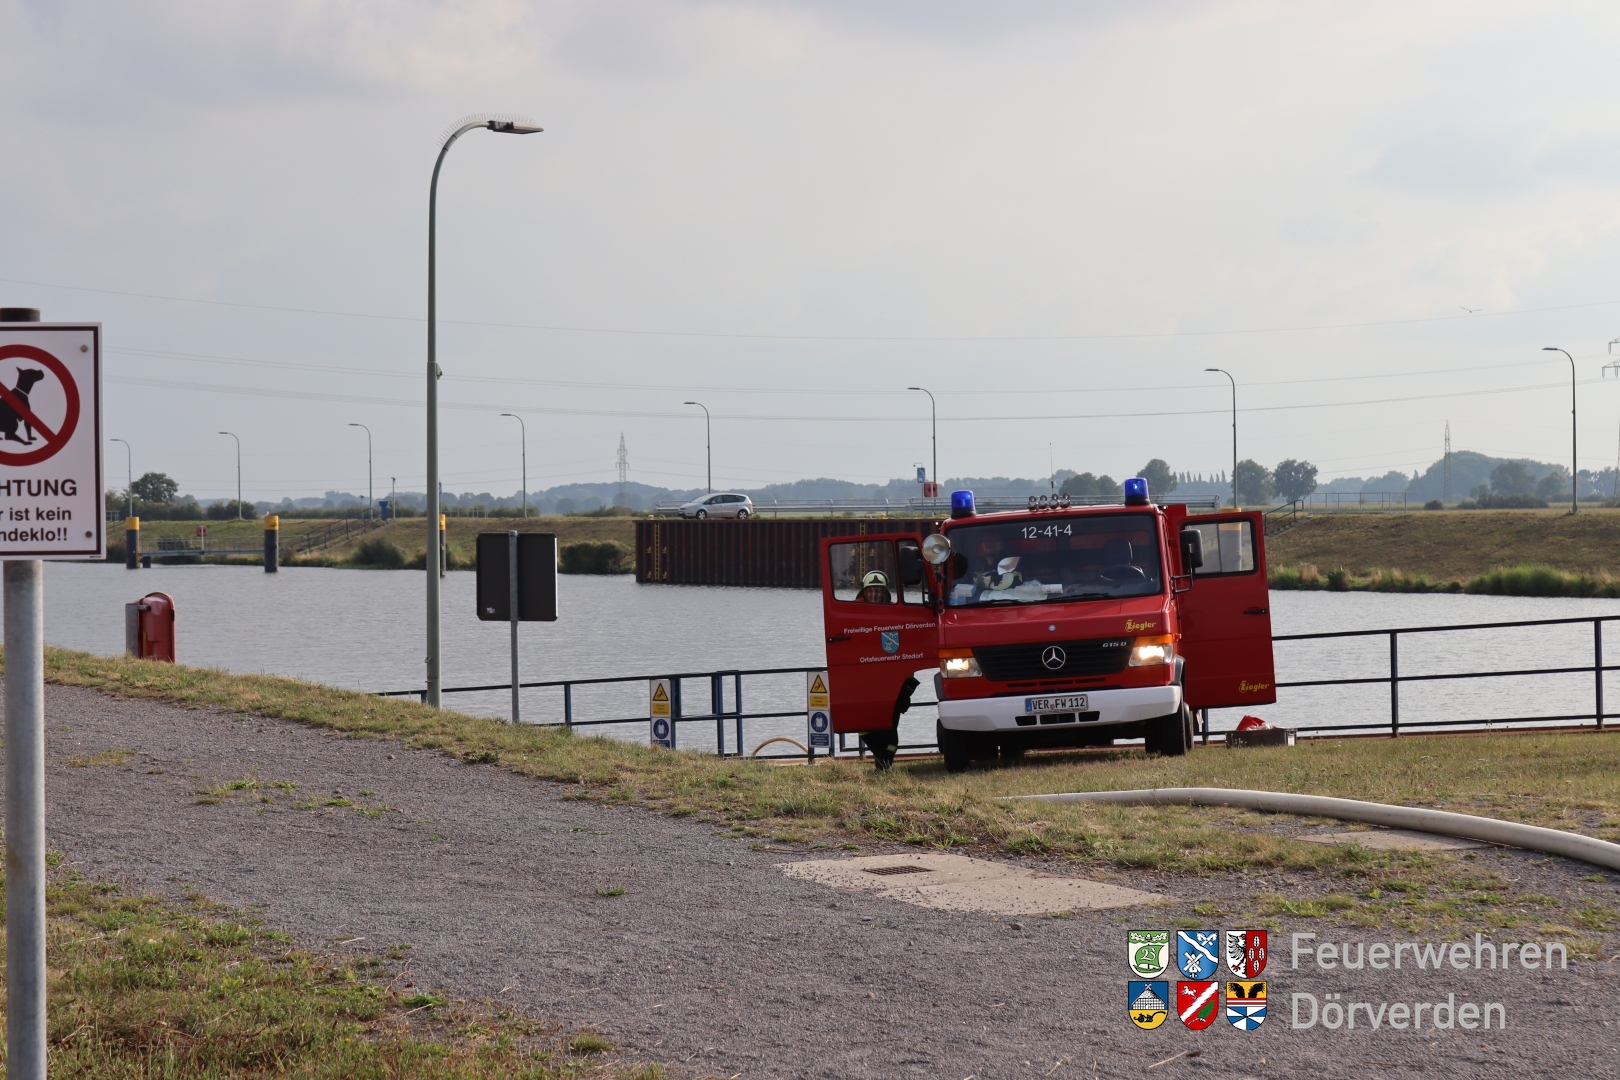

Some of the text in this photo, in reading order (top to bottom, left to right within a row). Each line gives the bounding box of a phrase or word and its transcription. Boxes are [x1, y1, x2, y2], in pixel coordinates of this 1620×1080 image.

[9, 507, 30, 521] ist
[36, 506, 72, 521] kein
[1021, 524, 1073, 539] 12-41-4
[873, 623, 904, 632] Feuerwehr
[859, 652, 924, 663] Ortsfeuerwehr Stedorf
[1032, 697, 1086, 710] VER FW 112
